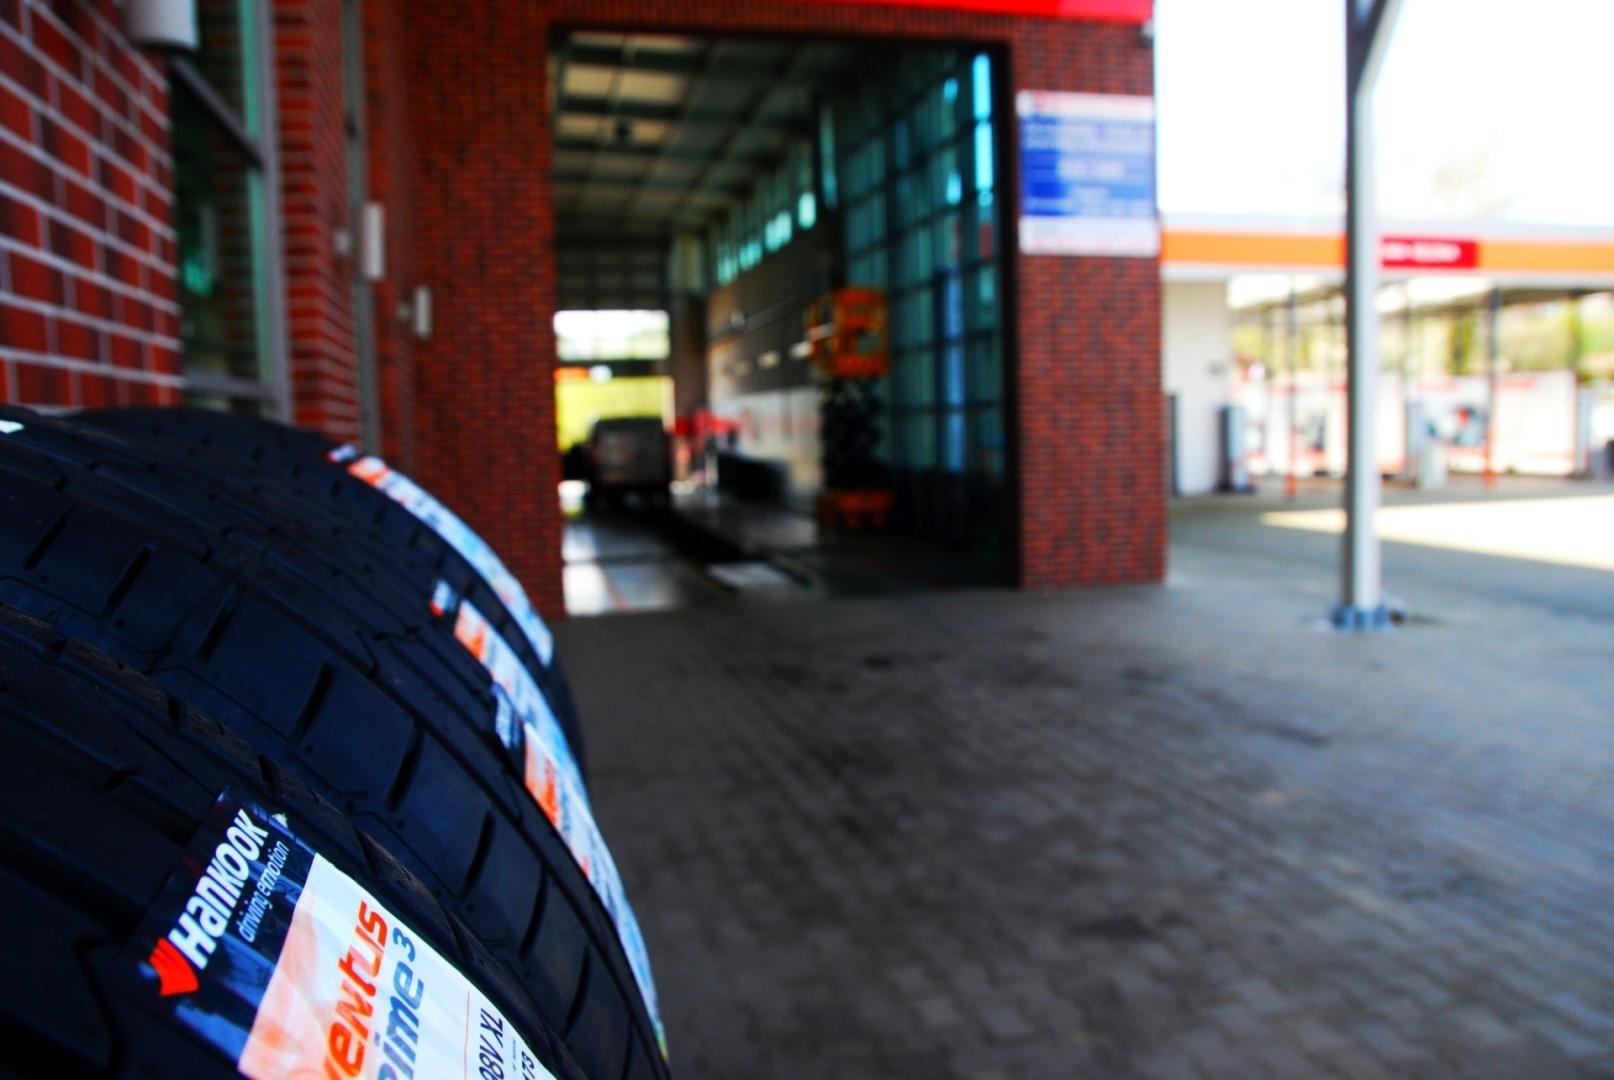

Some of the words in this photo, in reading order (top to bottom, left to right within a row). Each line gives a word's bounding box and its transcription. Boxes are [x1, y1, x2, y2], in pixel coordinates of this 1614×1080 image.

[236, 890, 273, 943] driving
[257, 840, 290, 897] emotion
[480, 1007, 504, 1049] XL
